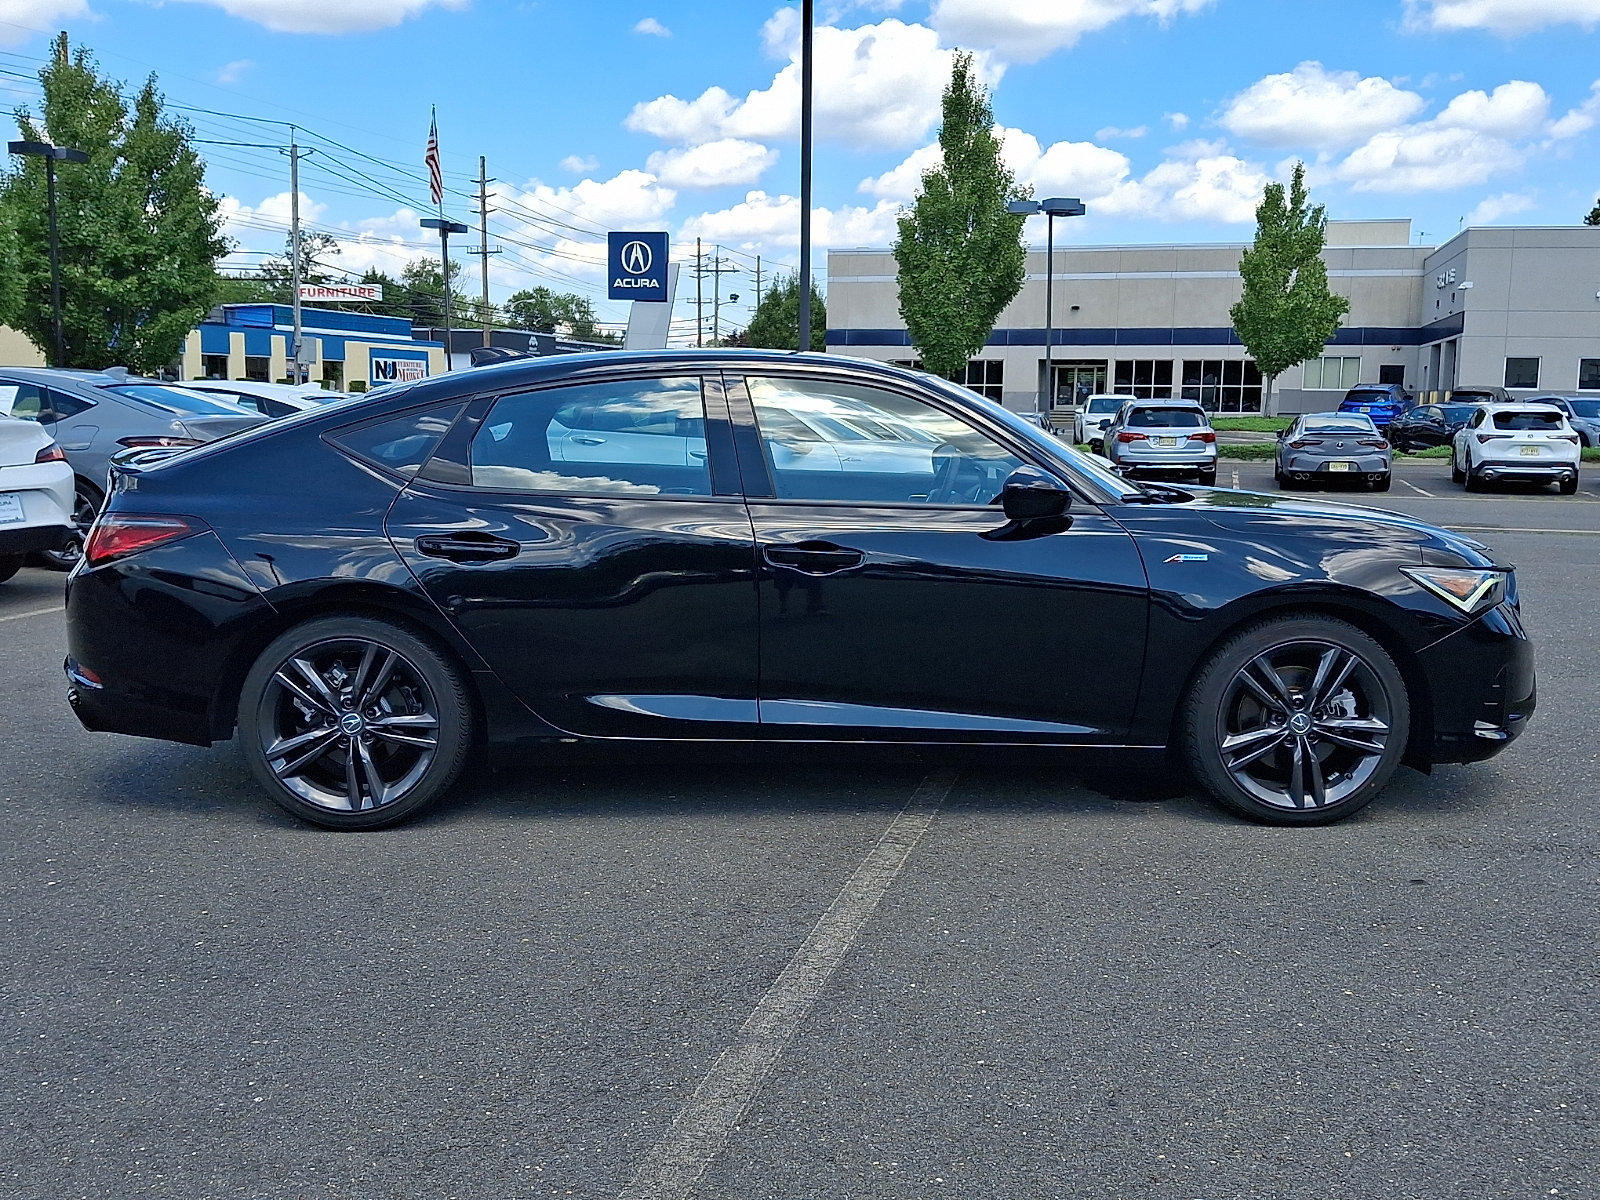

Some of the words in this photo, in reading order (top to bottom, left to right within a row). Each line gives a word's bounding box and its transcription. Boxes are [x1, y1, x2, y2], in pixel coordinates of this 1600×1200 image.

[613, 278, 660, 288] ACURA
[300, 287, 375, 298] FURNITURE
[375, 360, 397, 380] NJ
